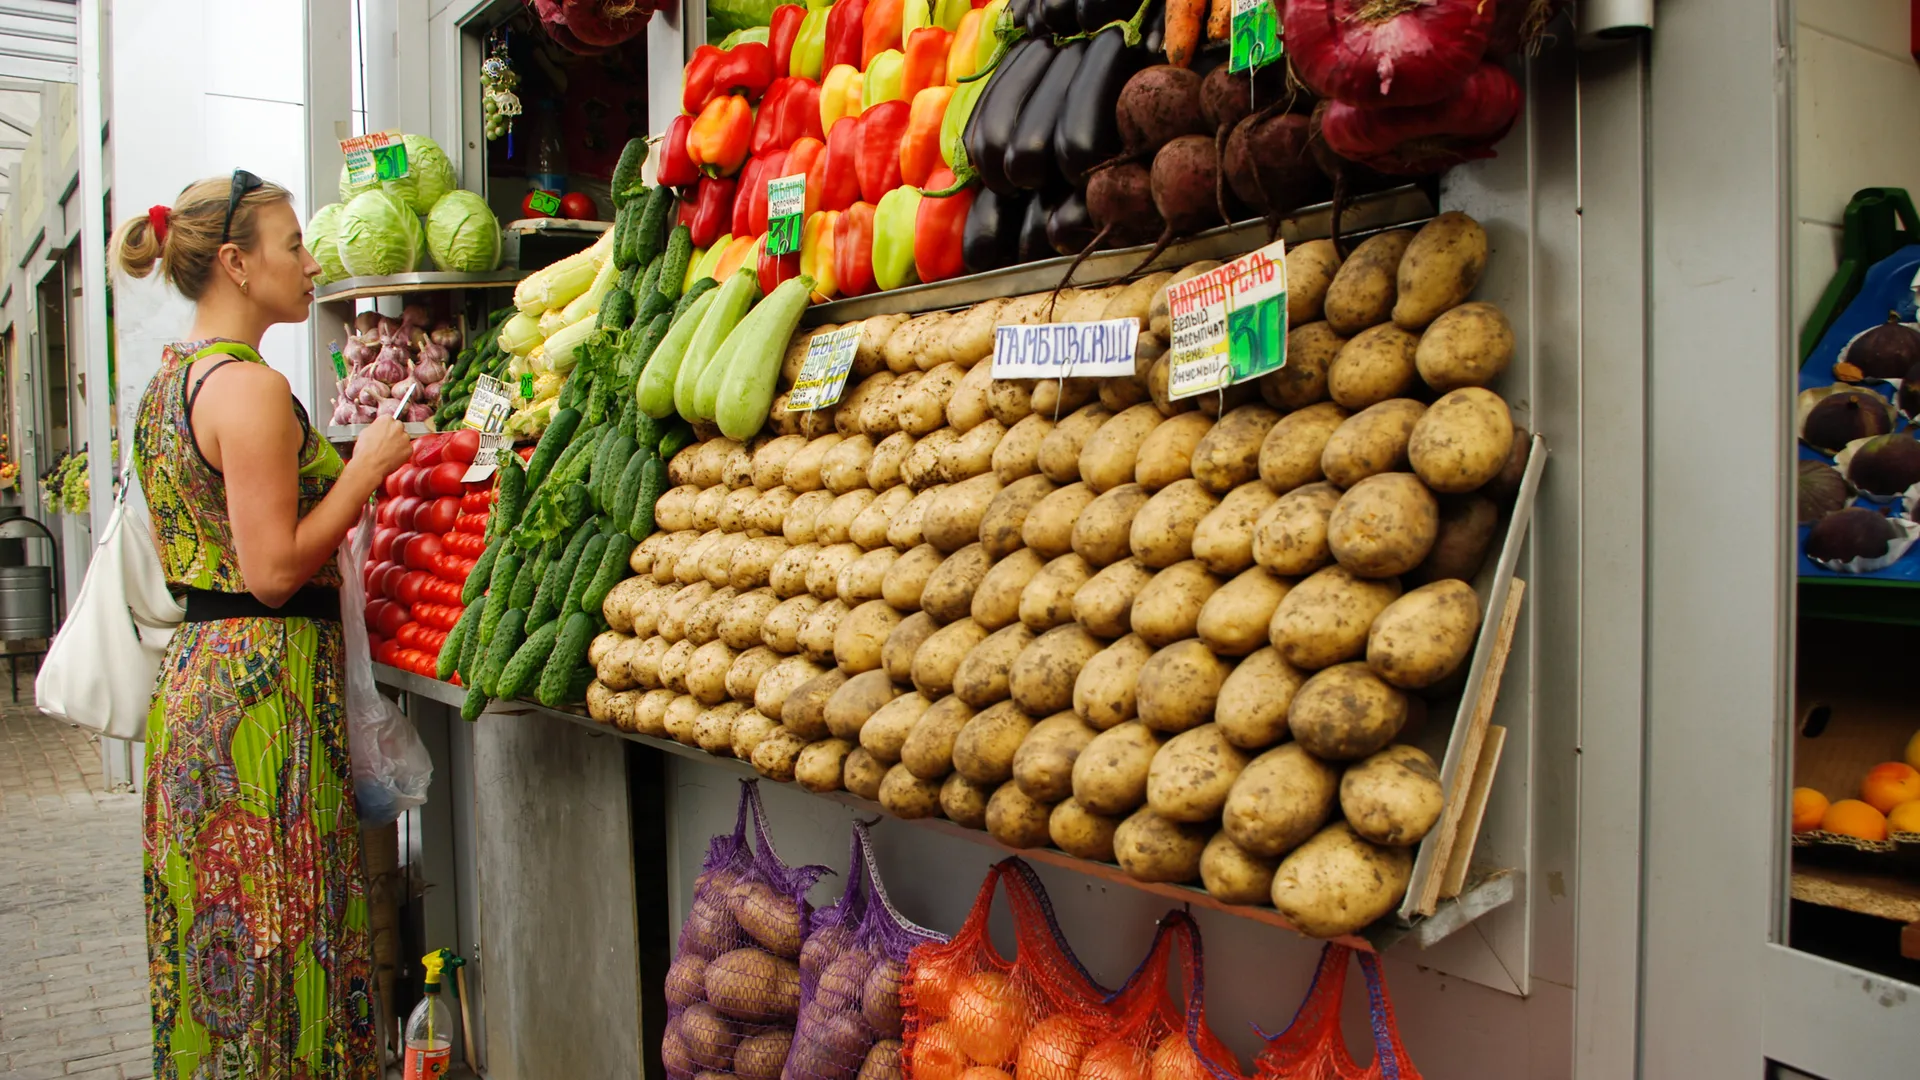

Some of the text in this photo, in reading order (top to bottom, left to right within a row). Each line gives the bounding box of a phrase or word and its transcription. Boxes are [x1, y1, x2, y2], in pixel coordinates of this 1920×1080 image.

[1232, 6, 1282, 71] 30
[373, 143, 408, 180] 30
[530, 191, 559, 214] 35
[766, 213, 804, 255] 30
[997, 318, 1132, 366] ТАМБОВСКИЙ
[1228, 295, 1286, 382] 30
[521, 375, 533, 397] 25
[483, 403, 510, 433] 60
